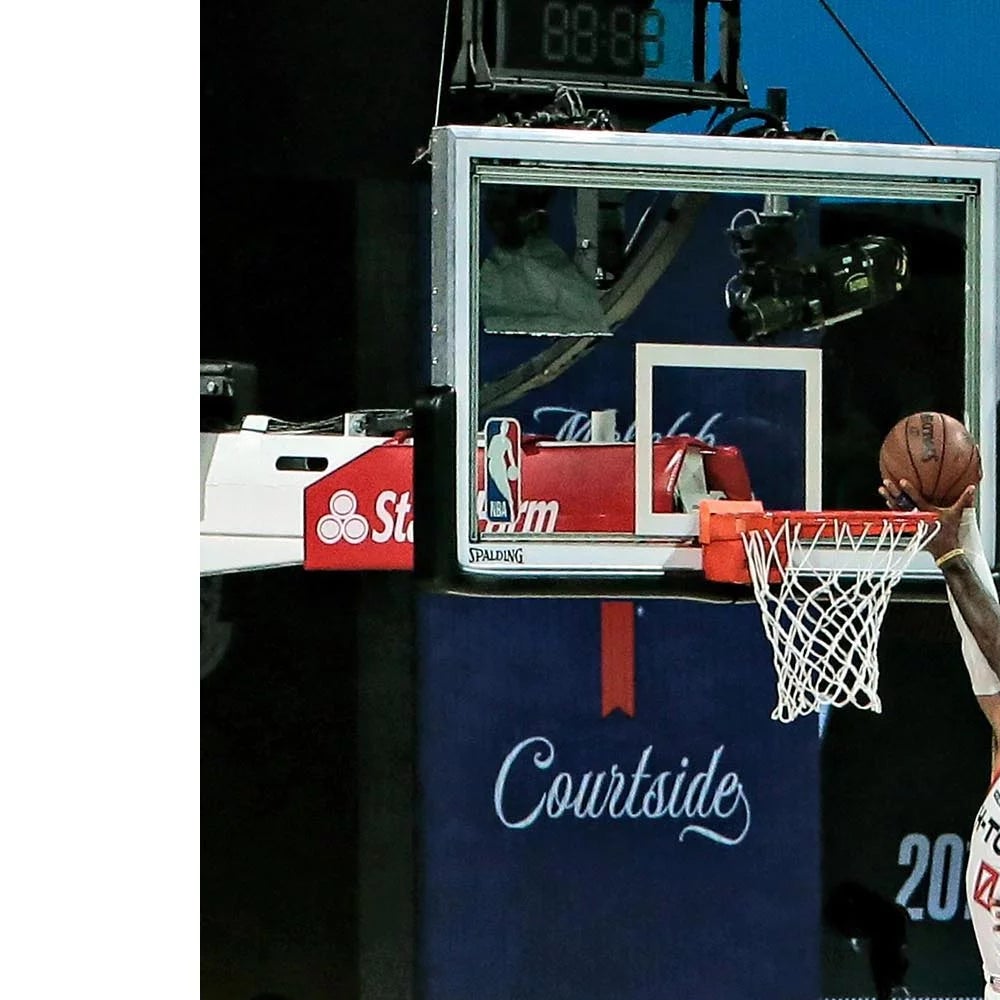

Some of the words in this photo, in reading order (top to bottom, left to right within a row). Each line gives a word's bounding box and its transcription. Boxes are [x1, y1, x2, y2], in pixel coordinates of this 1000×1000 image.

[489, 499, 508, 519] NBA
[468, 547, 523, 564] SPALDING
[495, 736, 751, 846] Courtside
[895, 832, 972, 923] 20
